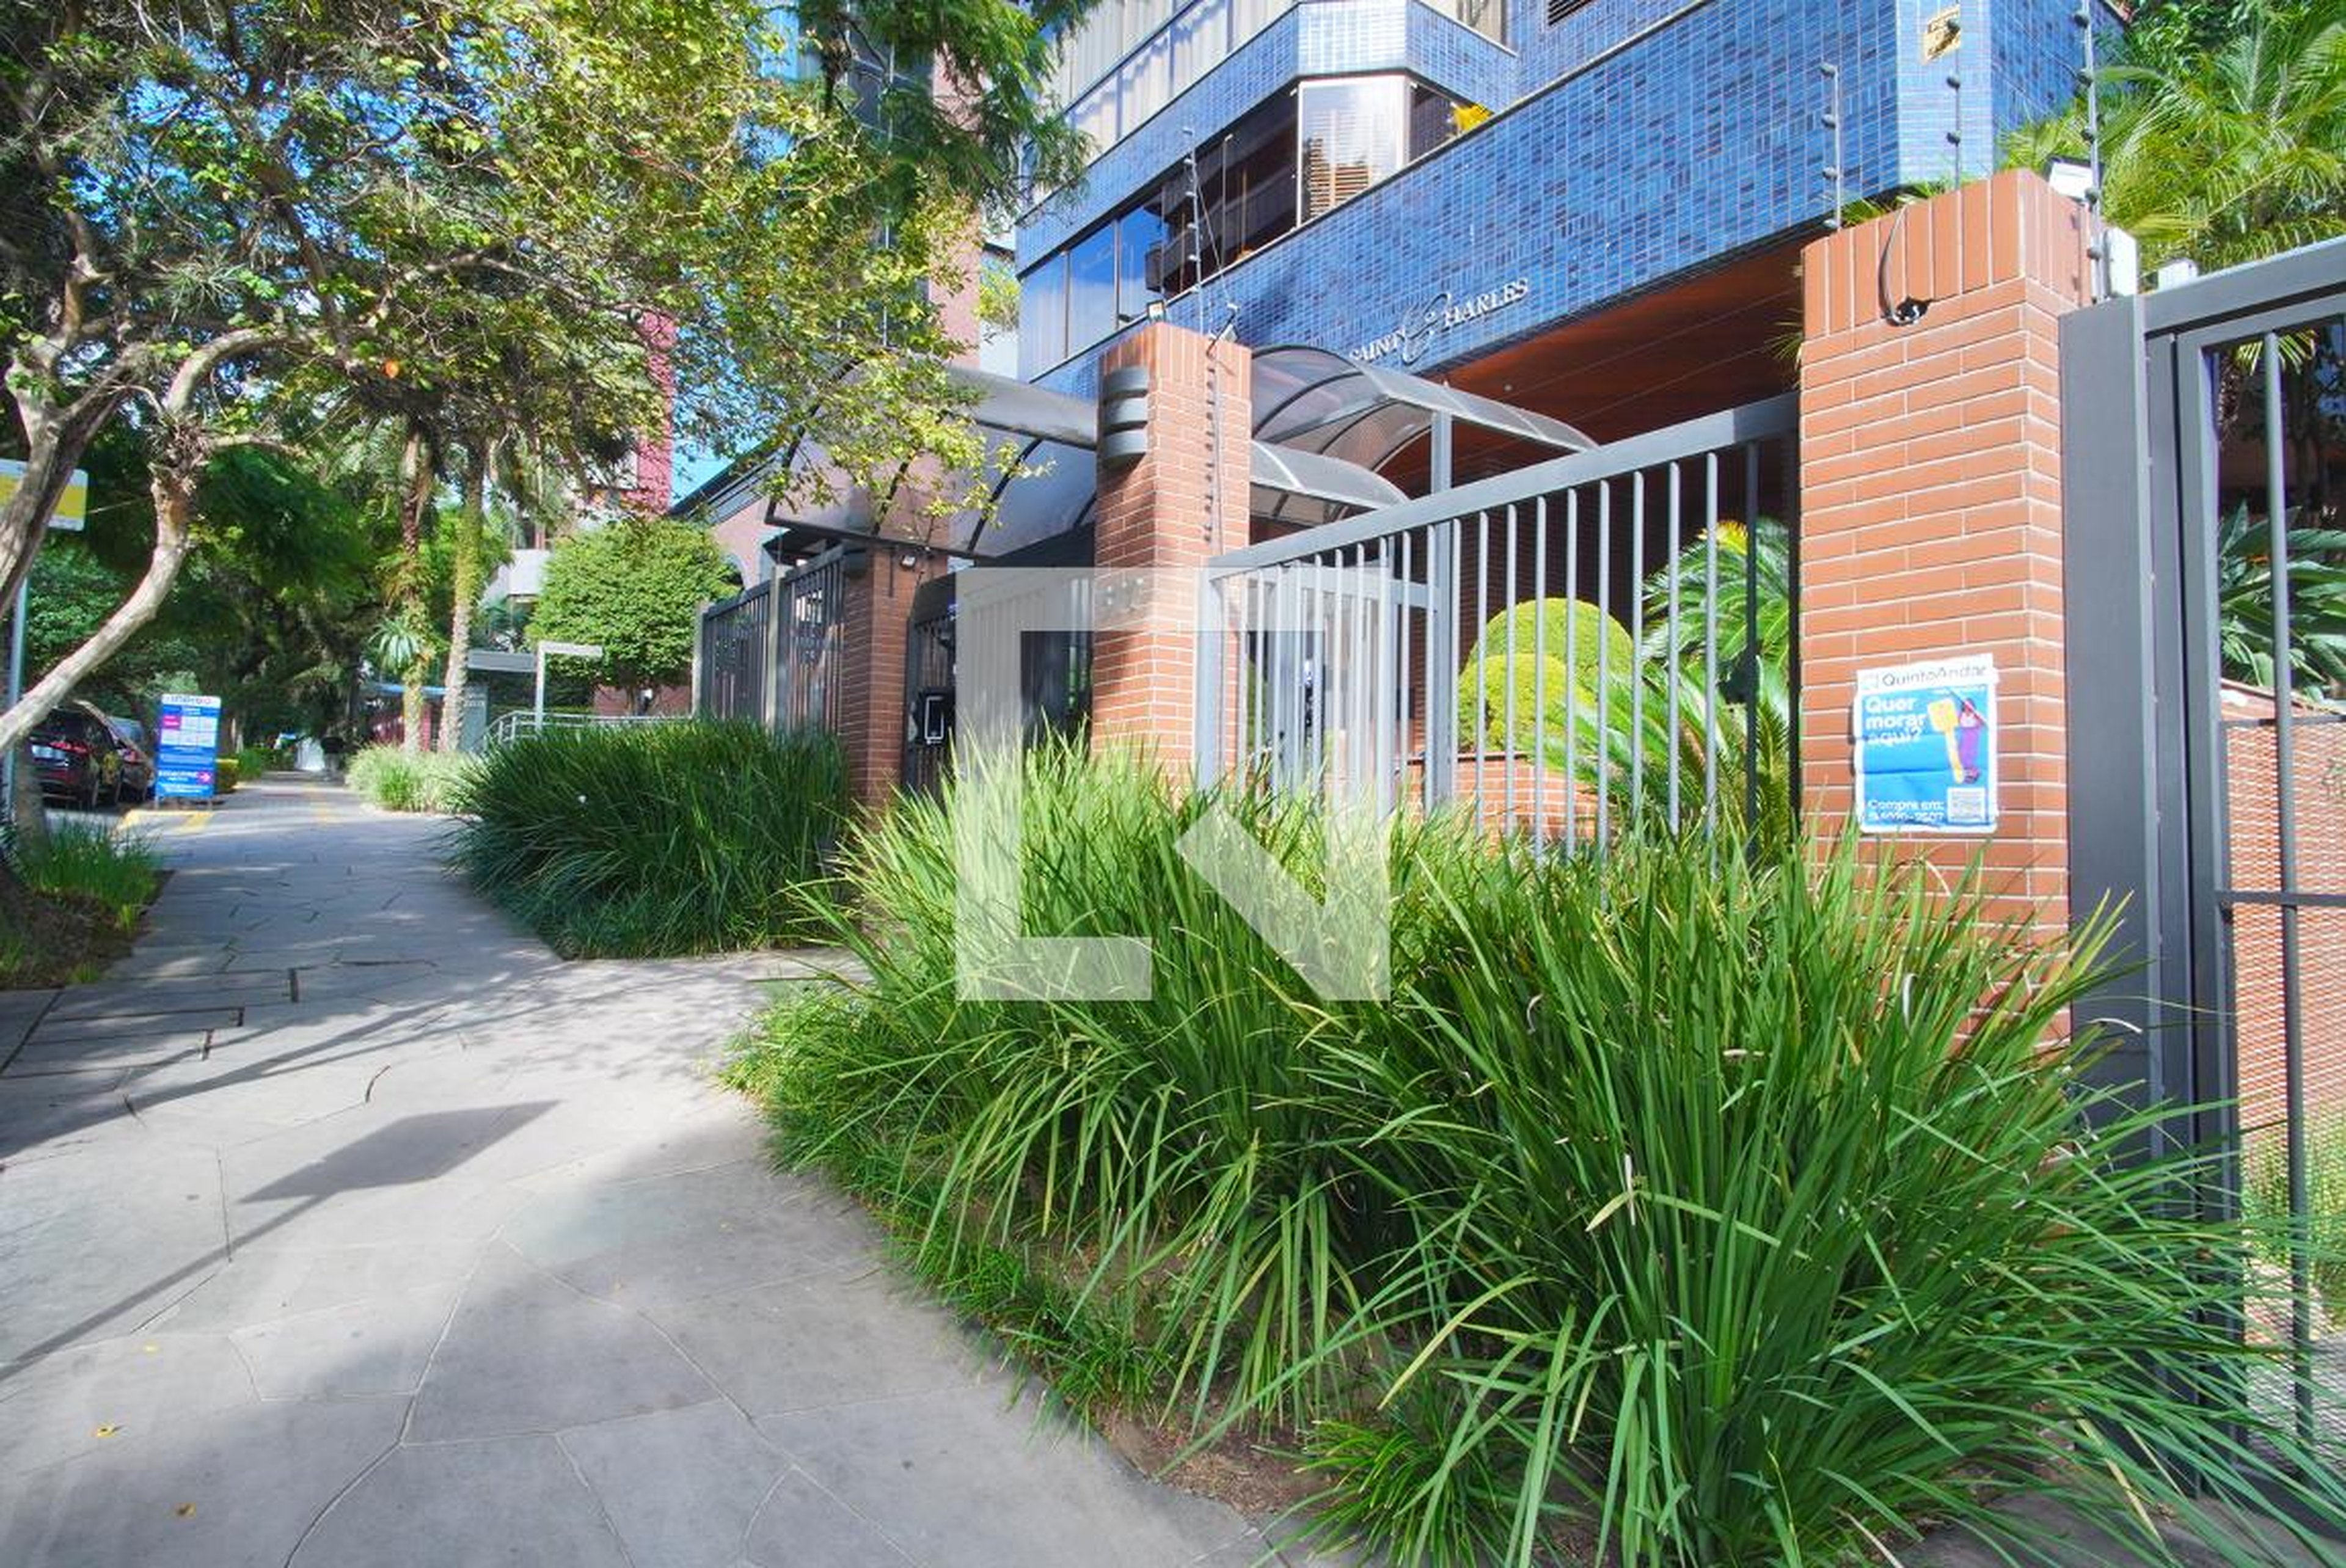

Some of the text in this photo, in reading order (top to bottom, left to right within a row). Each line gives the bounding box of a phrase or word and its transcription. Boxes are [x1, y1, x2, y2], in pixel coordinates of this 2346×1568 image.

[1401, 278, 1528, 366] CHARLES
[1882, 666, 1986, 687] QuintoAndar
[1865, 697, 1916, 713] Quer
[1865, 713, 1926, 731] morar
